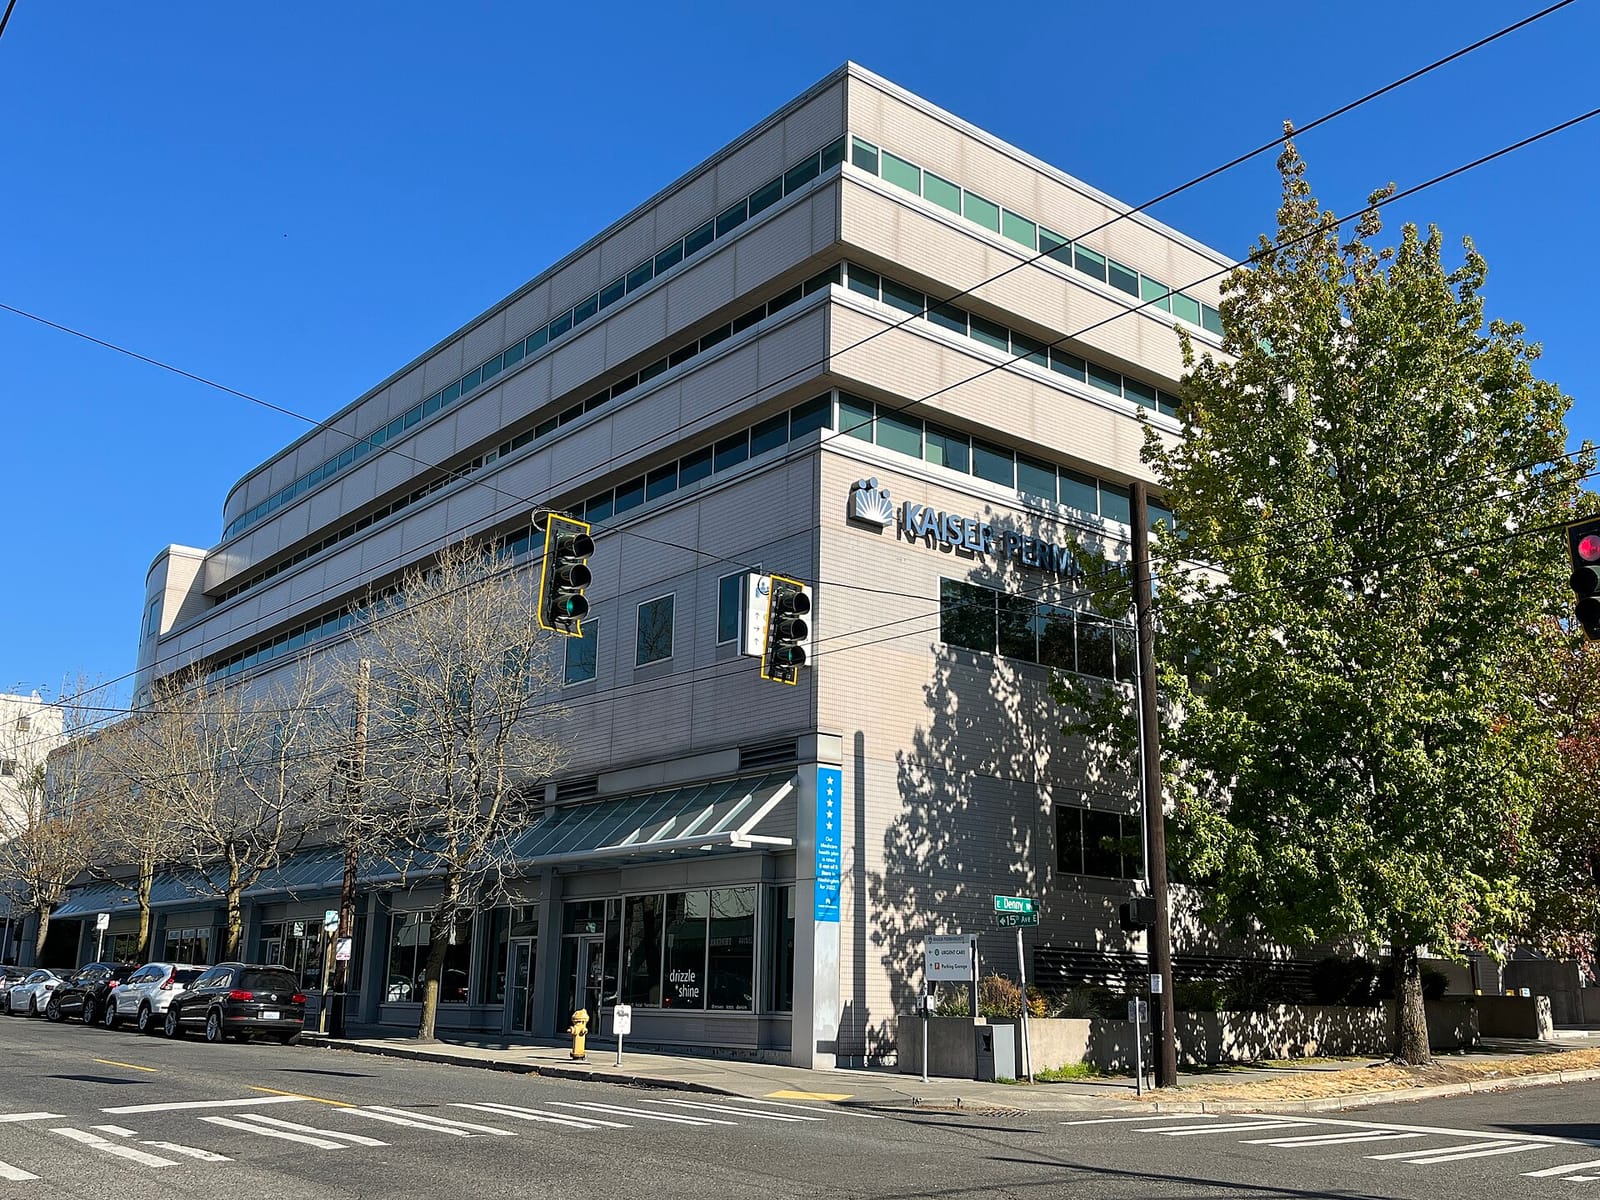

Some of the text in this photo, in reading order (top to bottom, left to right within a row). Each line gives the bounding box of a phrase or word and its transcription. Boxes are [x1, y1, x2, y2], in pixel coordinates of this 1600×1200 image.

[903, 500, 994, 554] KAISER
[996, 900, 1001, 908] E
[1003, 898, 1023, 911] Denny
[1021, 915, 1031, 923] Ave
[1032, 914, 1037, 923] E
[669, 969, 696, 983] drizzle
[678, 984, 700, 998] shine
